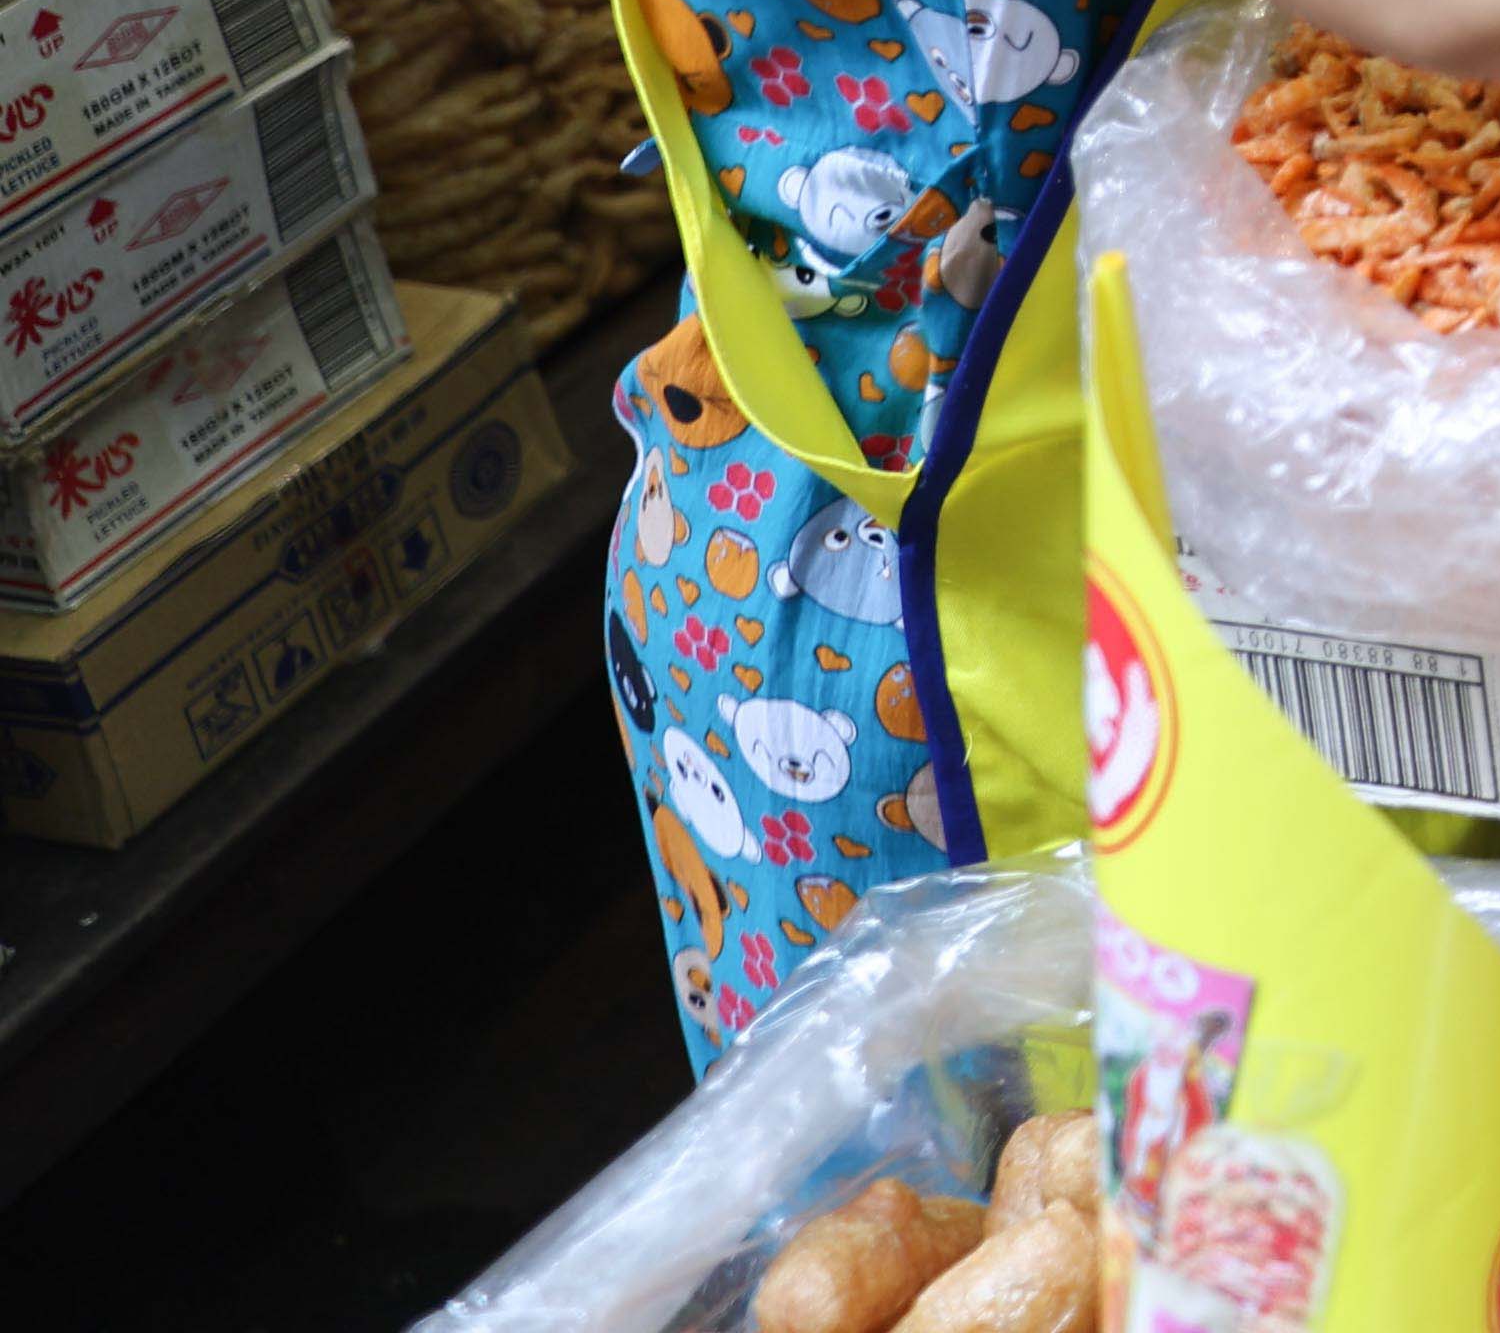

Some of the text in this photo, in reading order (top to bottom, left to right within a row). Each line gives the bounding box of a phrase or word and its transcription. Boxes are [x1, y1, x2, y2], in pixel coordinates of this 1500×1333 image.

[38, 34, 65, 59] UP
[93, 108, 135, 138] MADE
[94, 221, 120, 244] UP
[4, 266, 105, 359] 菜心
[42, 316, 100, 359] PICKLED
[43, 331, 105, 378] LETTUCE
[87, 480, 141, 527] PICKLED
[93, 492, 151, 543] LETTUCE
[1322, 640, 1394, 668] 88380
[1412, 653, 1438, 673] 88
